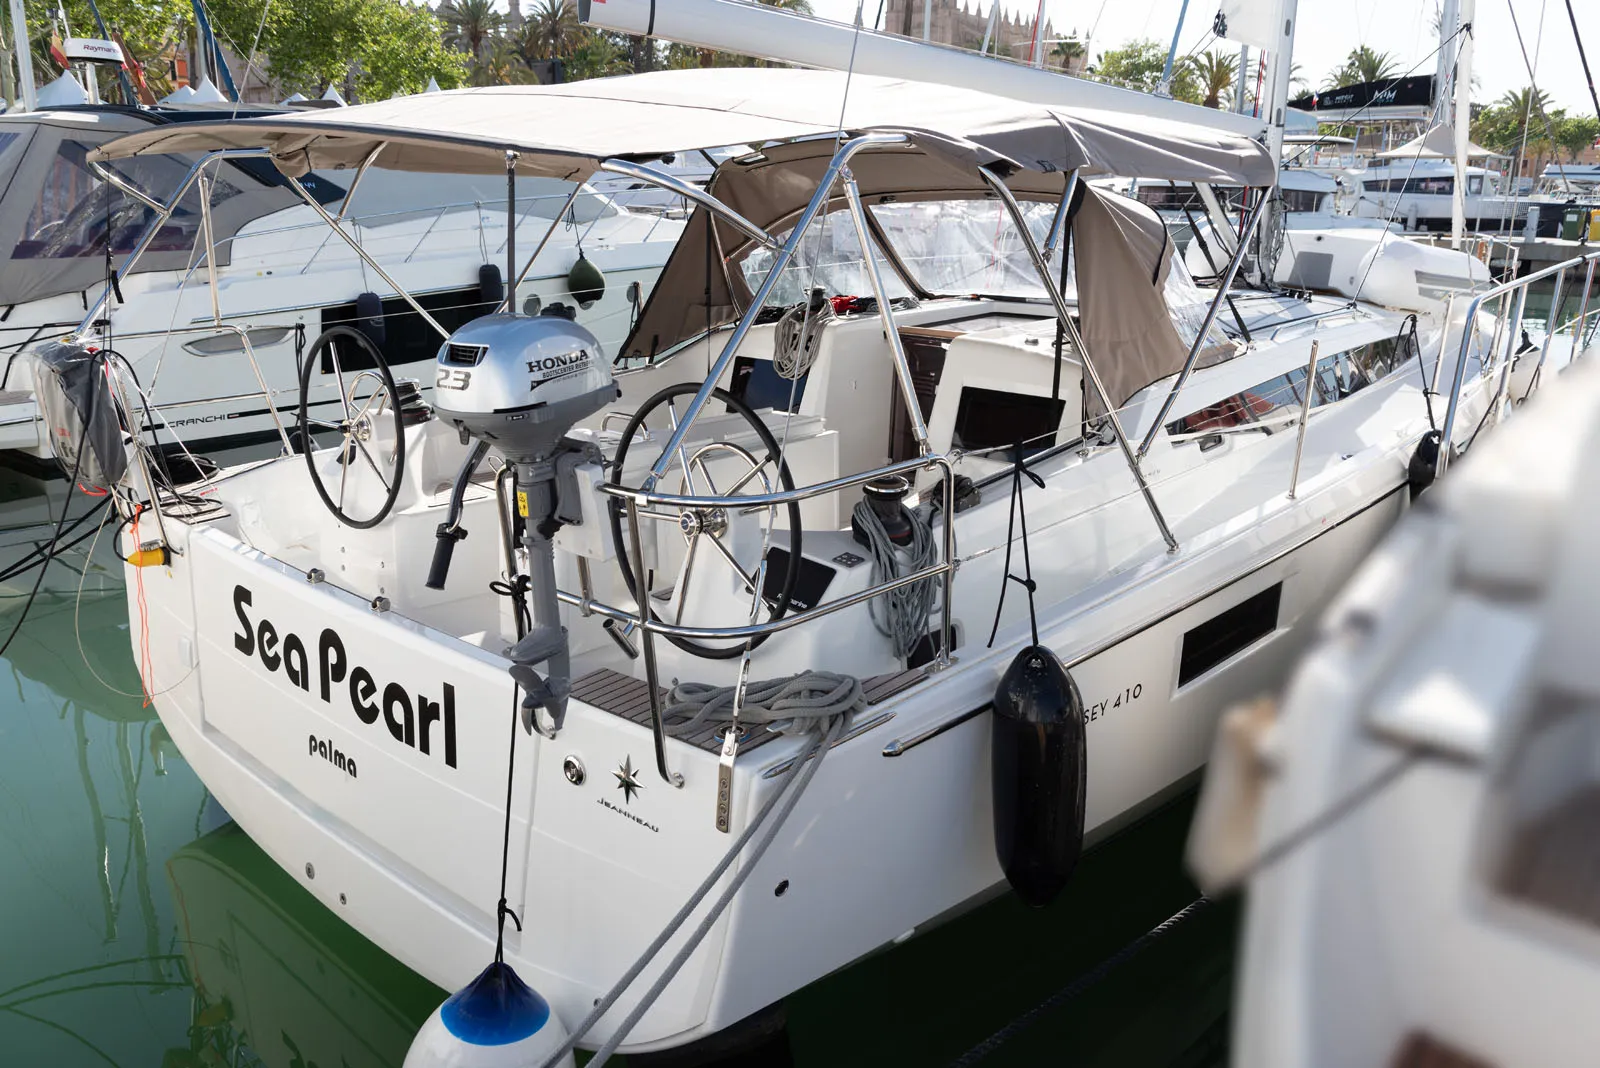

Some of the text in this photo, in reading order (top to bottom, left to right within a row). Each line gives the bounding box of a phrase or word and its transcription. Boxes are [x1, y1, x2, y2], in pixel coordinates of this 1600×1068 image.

[436, 368, 472, 391] 23
[526, 349, 590, 374] HONDA
[233, 584, 457, 770] Sea Pearl
[1083, 683, 1142, 725] SEY 410
[309, 734, 357, 778] palma
[597, 797, 659, 832] JEANNEAU
